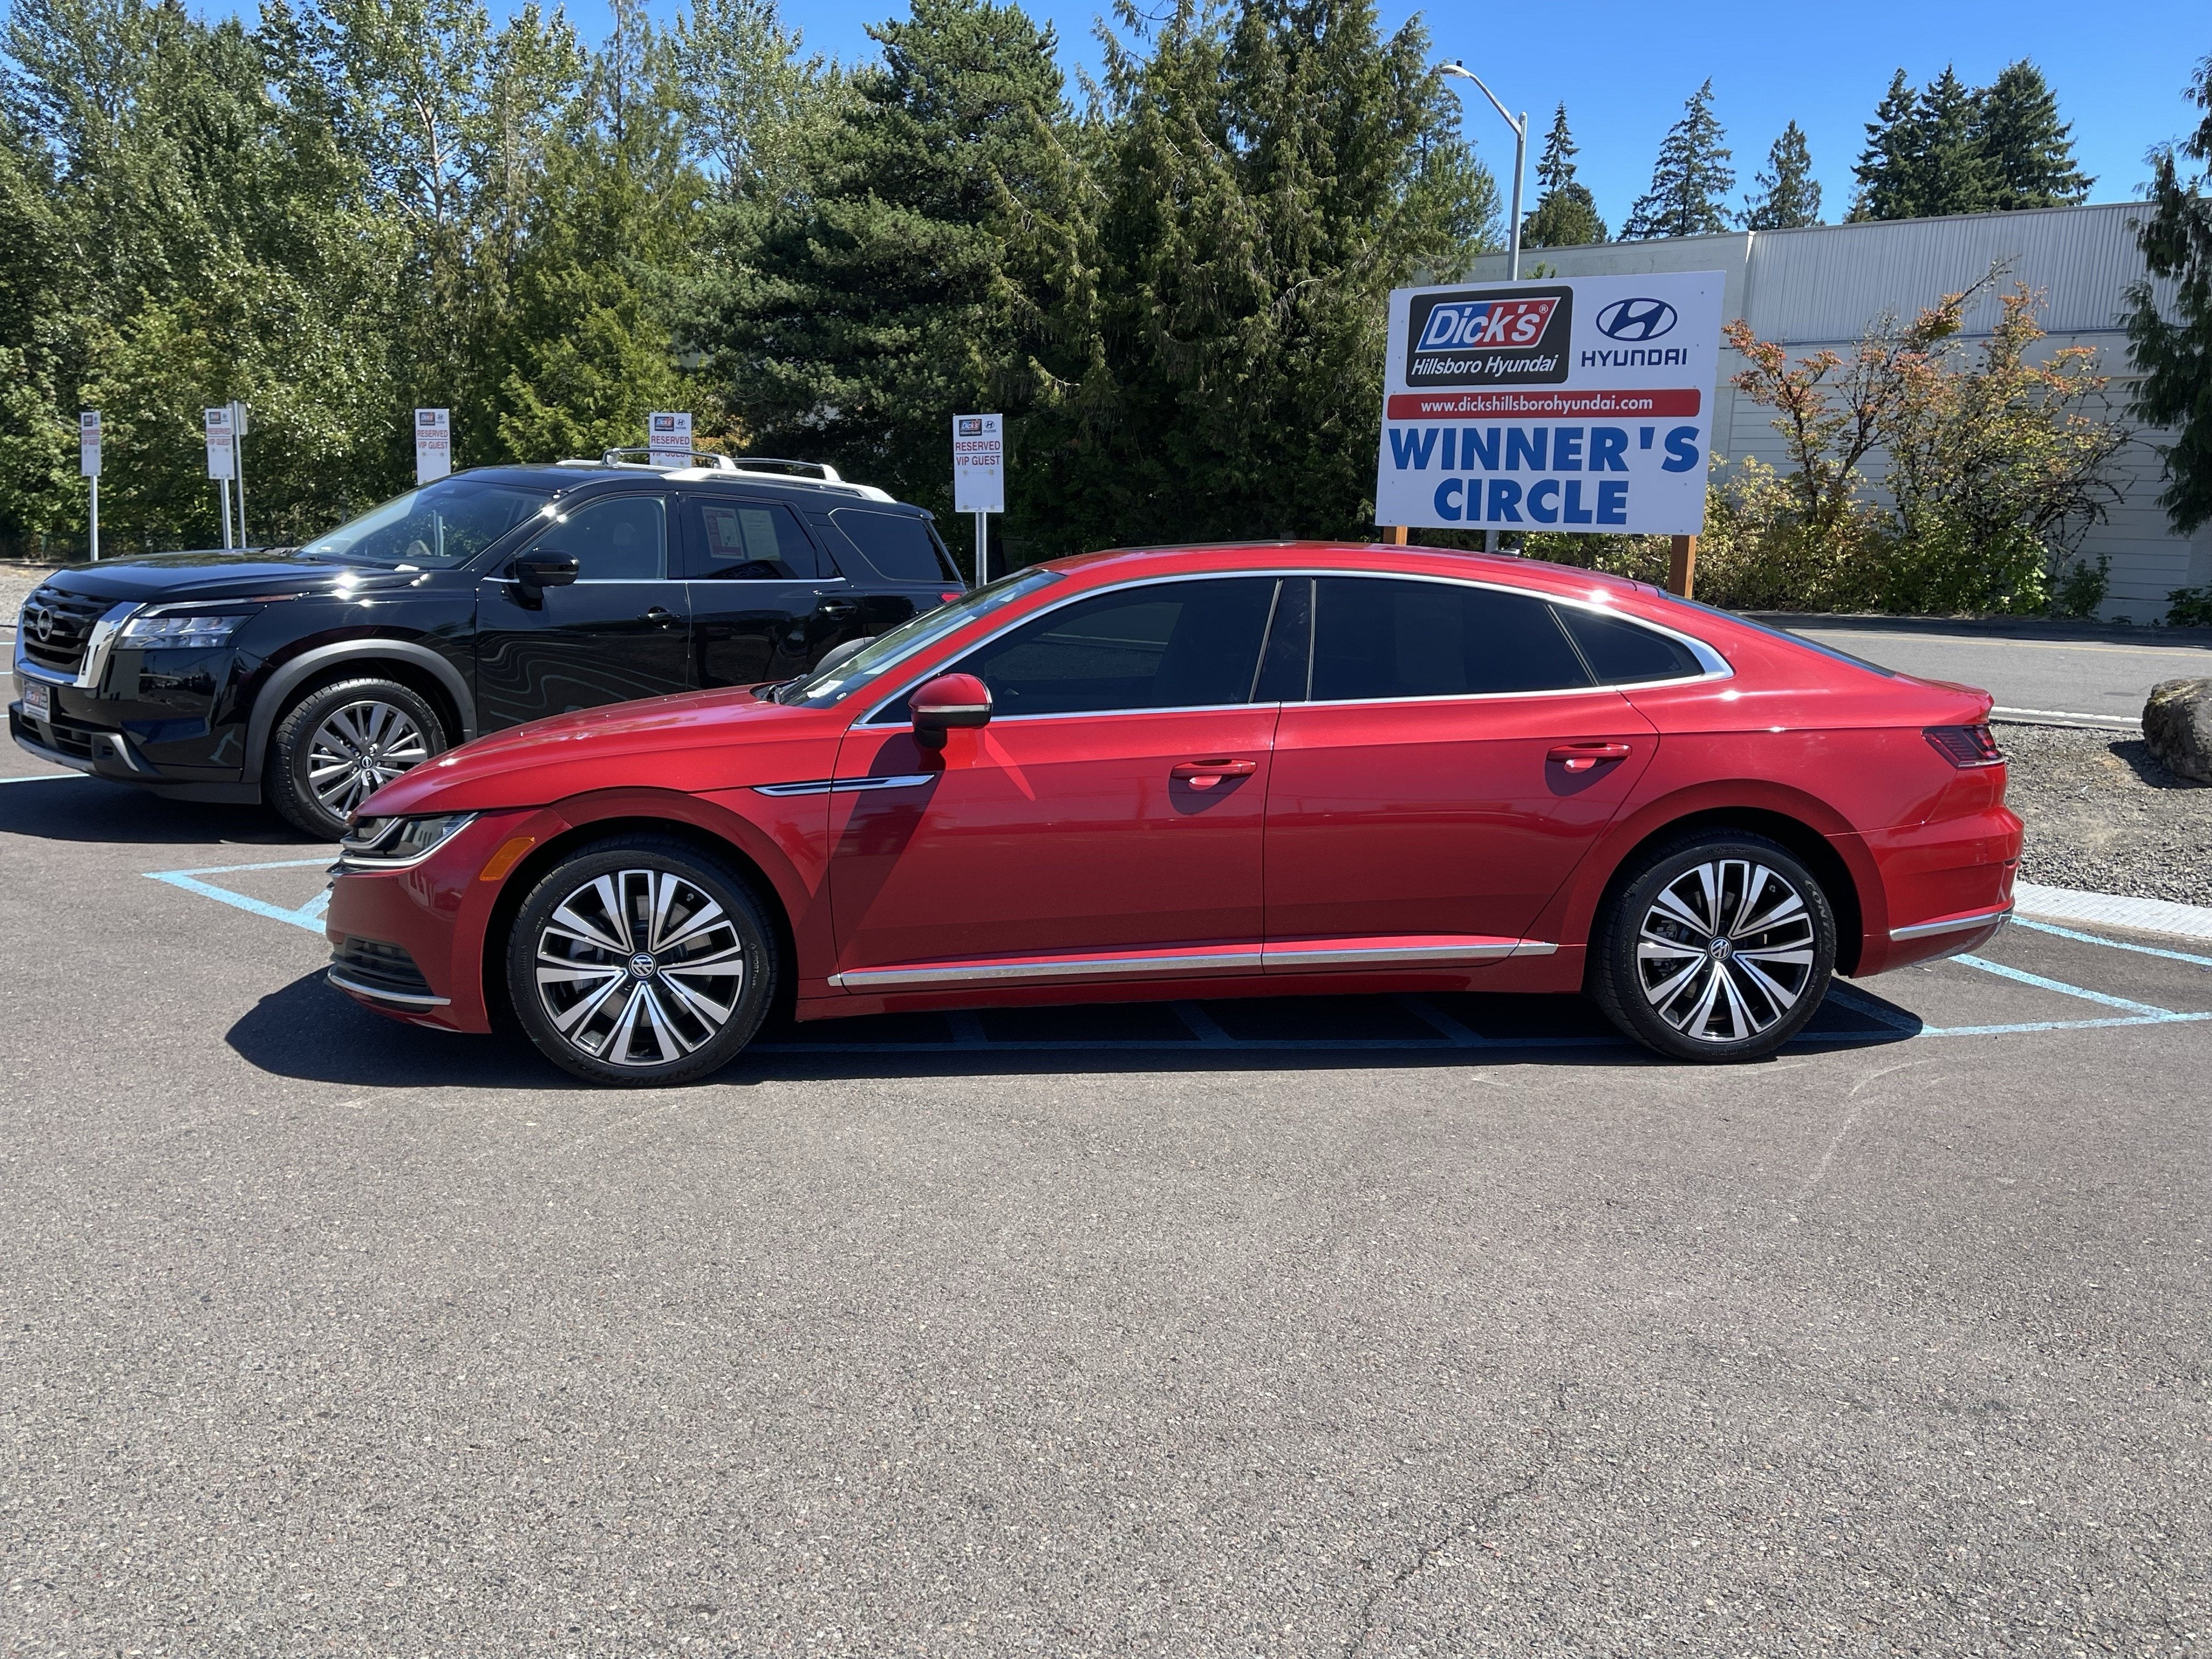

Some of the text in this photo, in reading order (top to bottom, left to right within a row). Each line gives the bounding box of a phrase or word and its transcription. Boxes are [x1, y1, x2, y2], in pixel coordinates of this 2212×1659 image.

[1426, 304, 1541, 345] Dick's
[1412, 354, 1559, 377] Hillsboro Hyundai
[1581, 348, 1687, 367] HYUNDAI
[1421, 394, 1653, 414] www.dickshillsborohyundai.com
[651, 436, 690, 445] RESERVED
[955, 441, 1000, 451] RESERVED
[1388, 426, 1700, 472] WINNER'S
[956, 455, 1000, 465] VIP GUEST
[1434, 478, 1629, 524] CIRCLE
